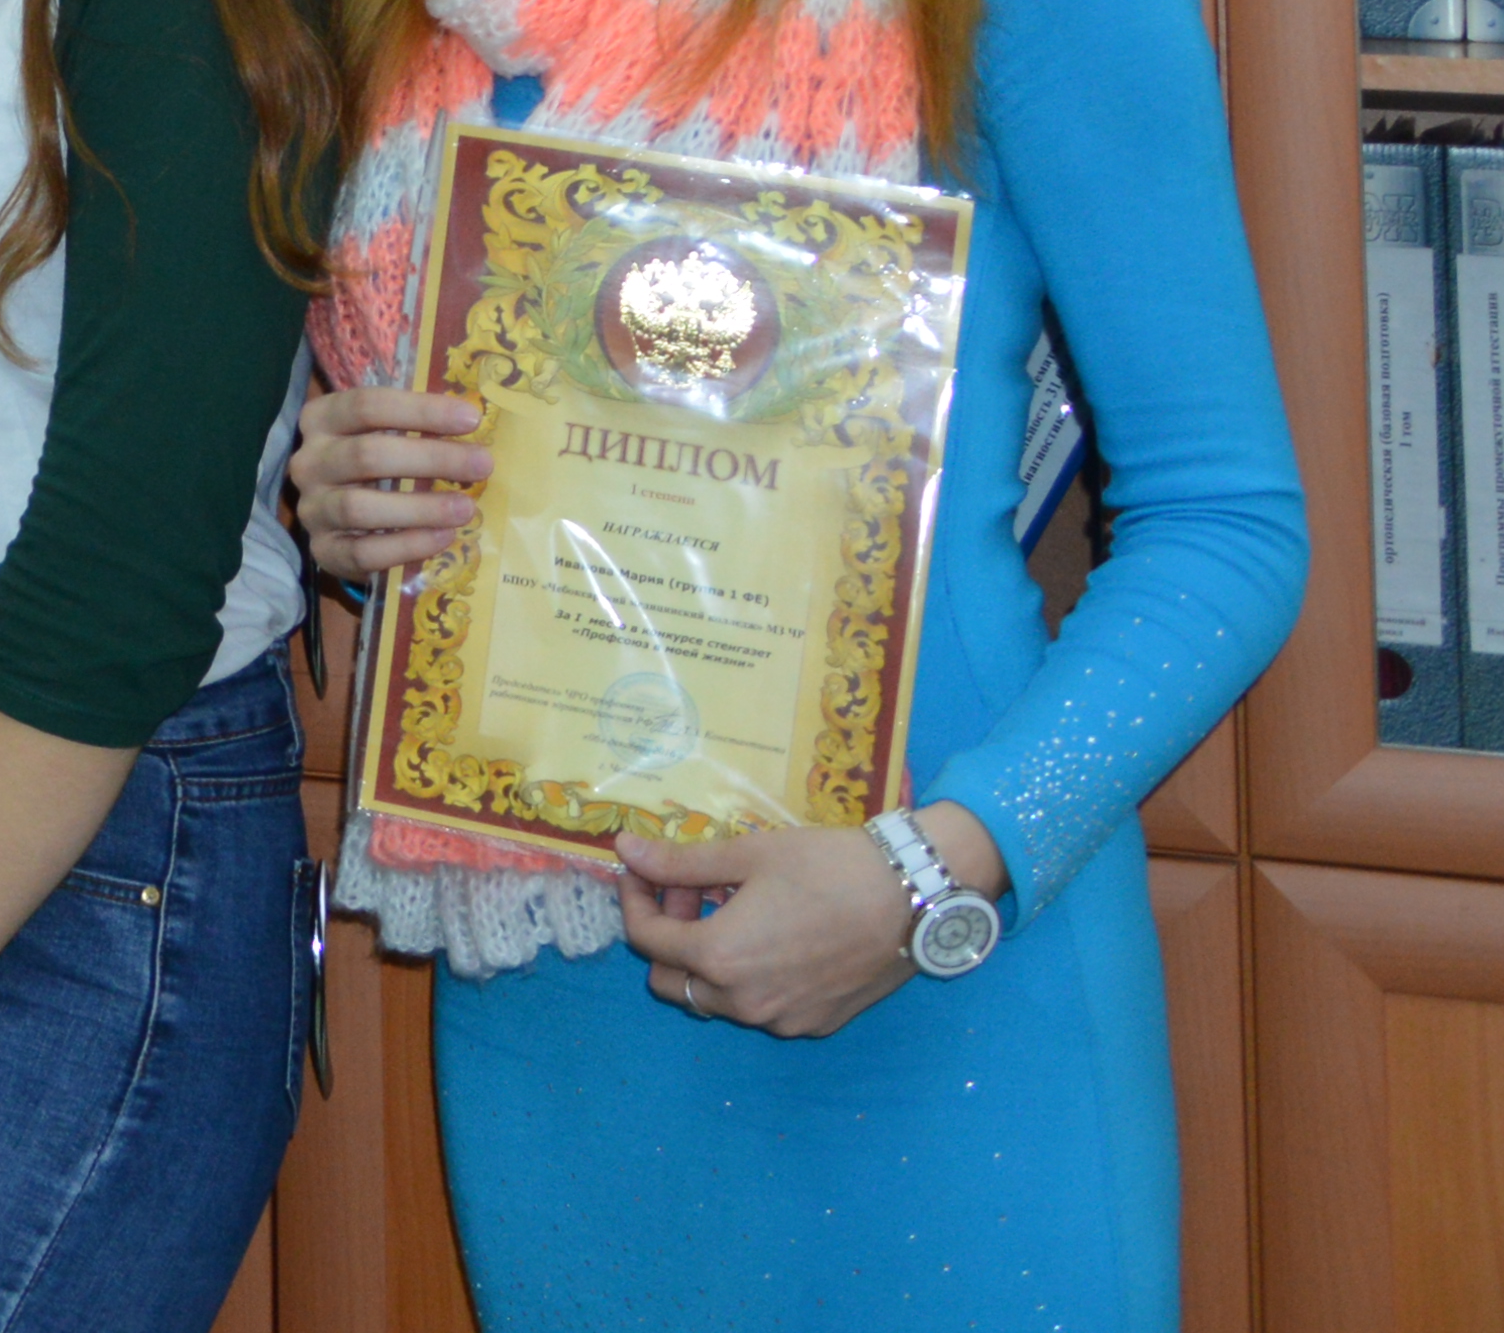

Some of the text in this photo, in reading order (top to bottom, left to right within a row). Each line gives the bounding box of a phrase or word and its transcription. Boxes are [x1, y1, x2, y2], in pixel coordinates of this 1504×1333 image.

[558, 422, 782, 491] ДИПЛОМ
[1378, 291, 1396, 565] ортопедическая (базовая подготовка)
[601, 520, 720, 552] НАГРАЖДАЕТСЯ
